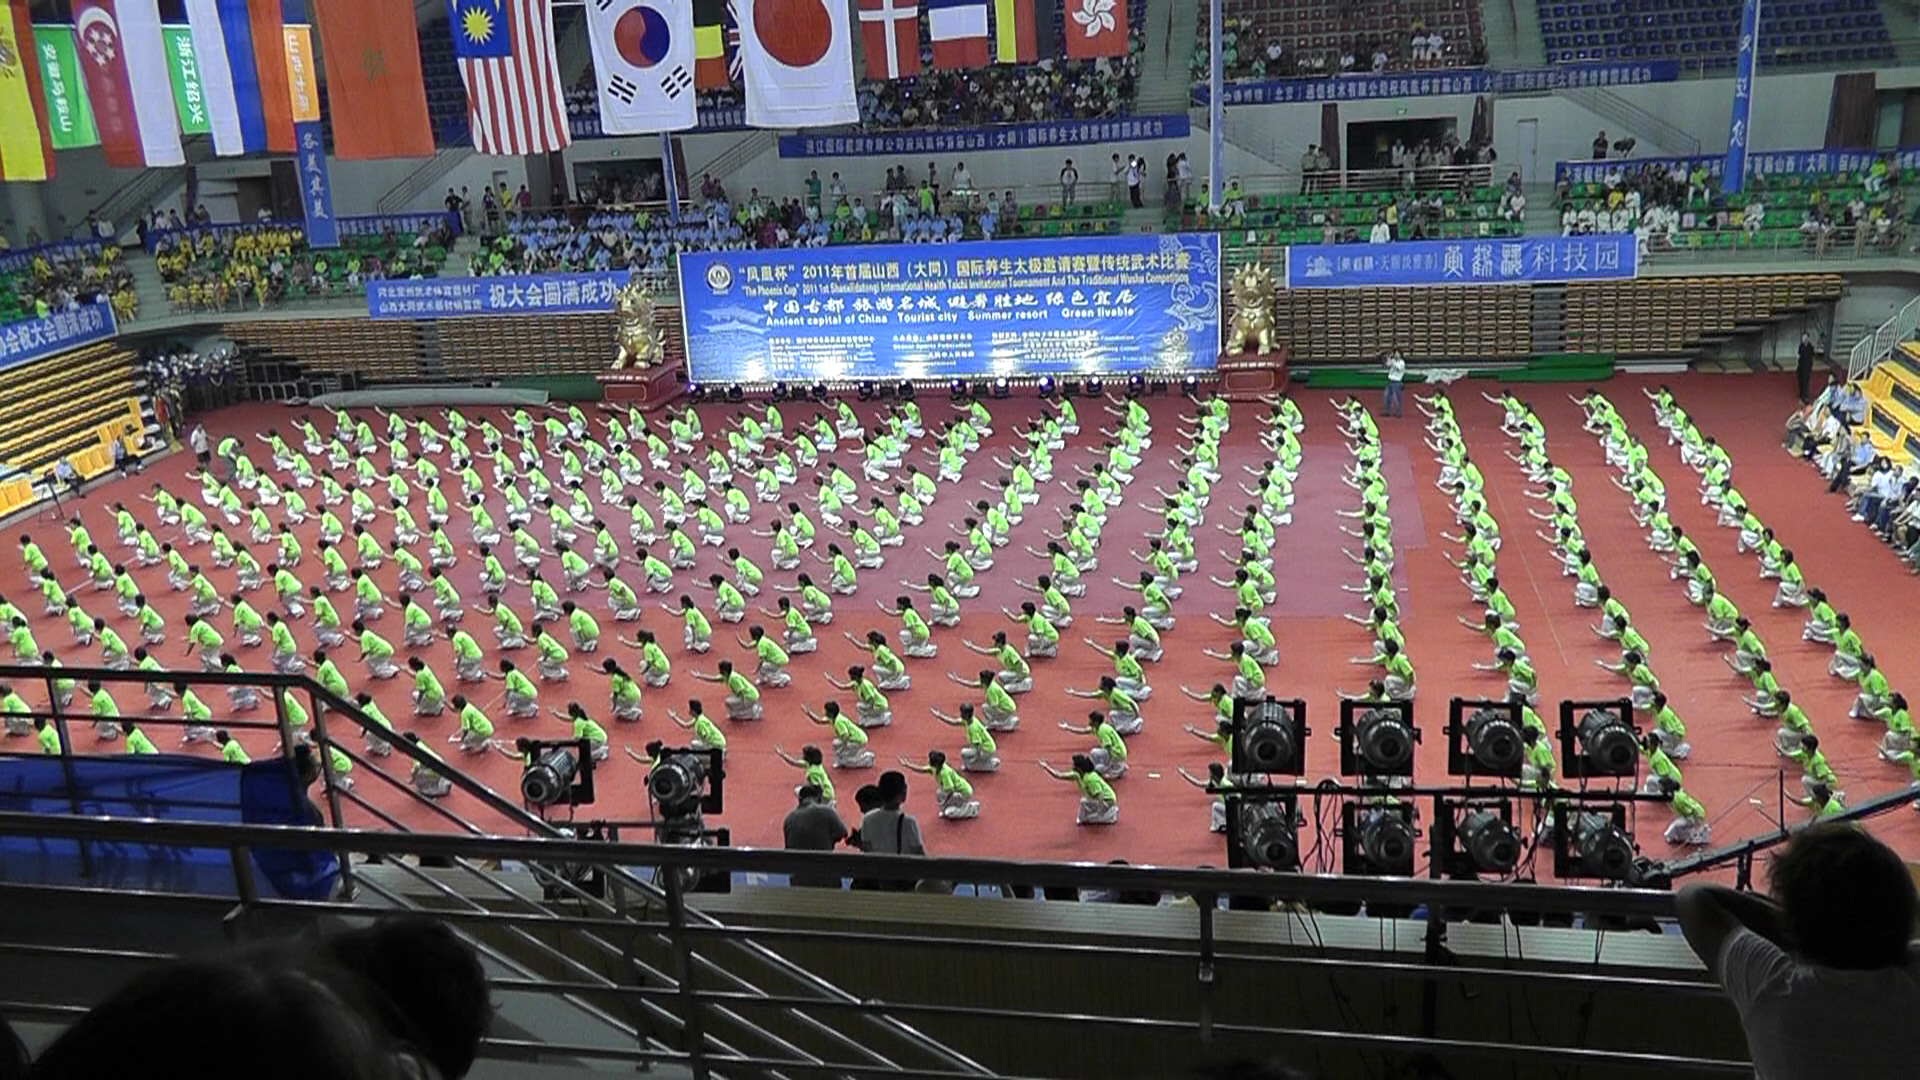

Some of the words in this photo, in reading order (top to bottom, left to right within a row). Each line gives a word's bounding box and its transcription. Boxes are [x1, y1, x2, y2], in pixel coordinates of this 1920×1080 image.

[766, 315, 805, 327] Ancient
[807, 314, 842, 328] capital
[844, 313, 856, 325] of
[858, 312, 888, 324] China
[898, 311, 935, 323] Tourist
[937, 310, 958, 324] city
[967, 309, 1012, 321] Summer
[1015, 308, 1048, 320] resort
[1061, 307, 1095, 318] Green
[1097, 306, 1135, 318] livable
